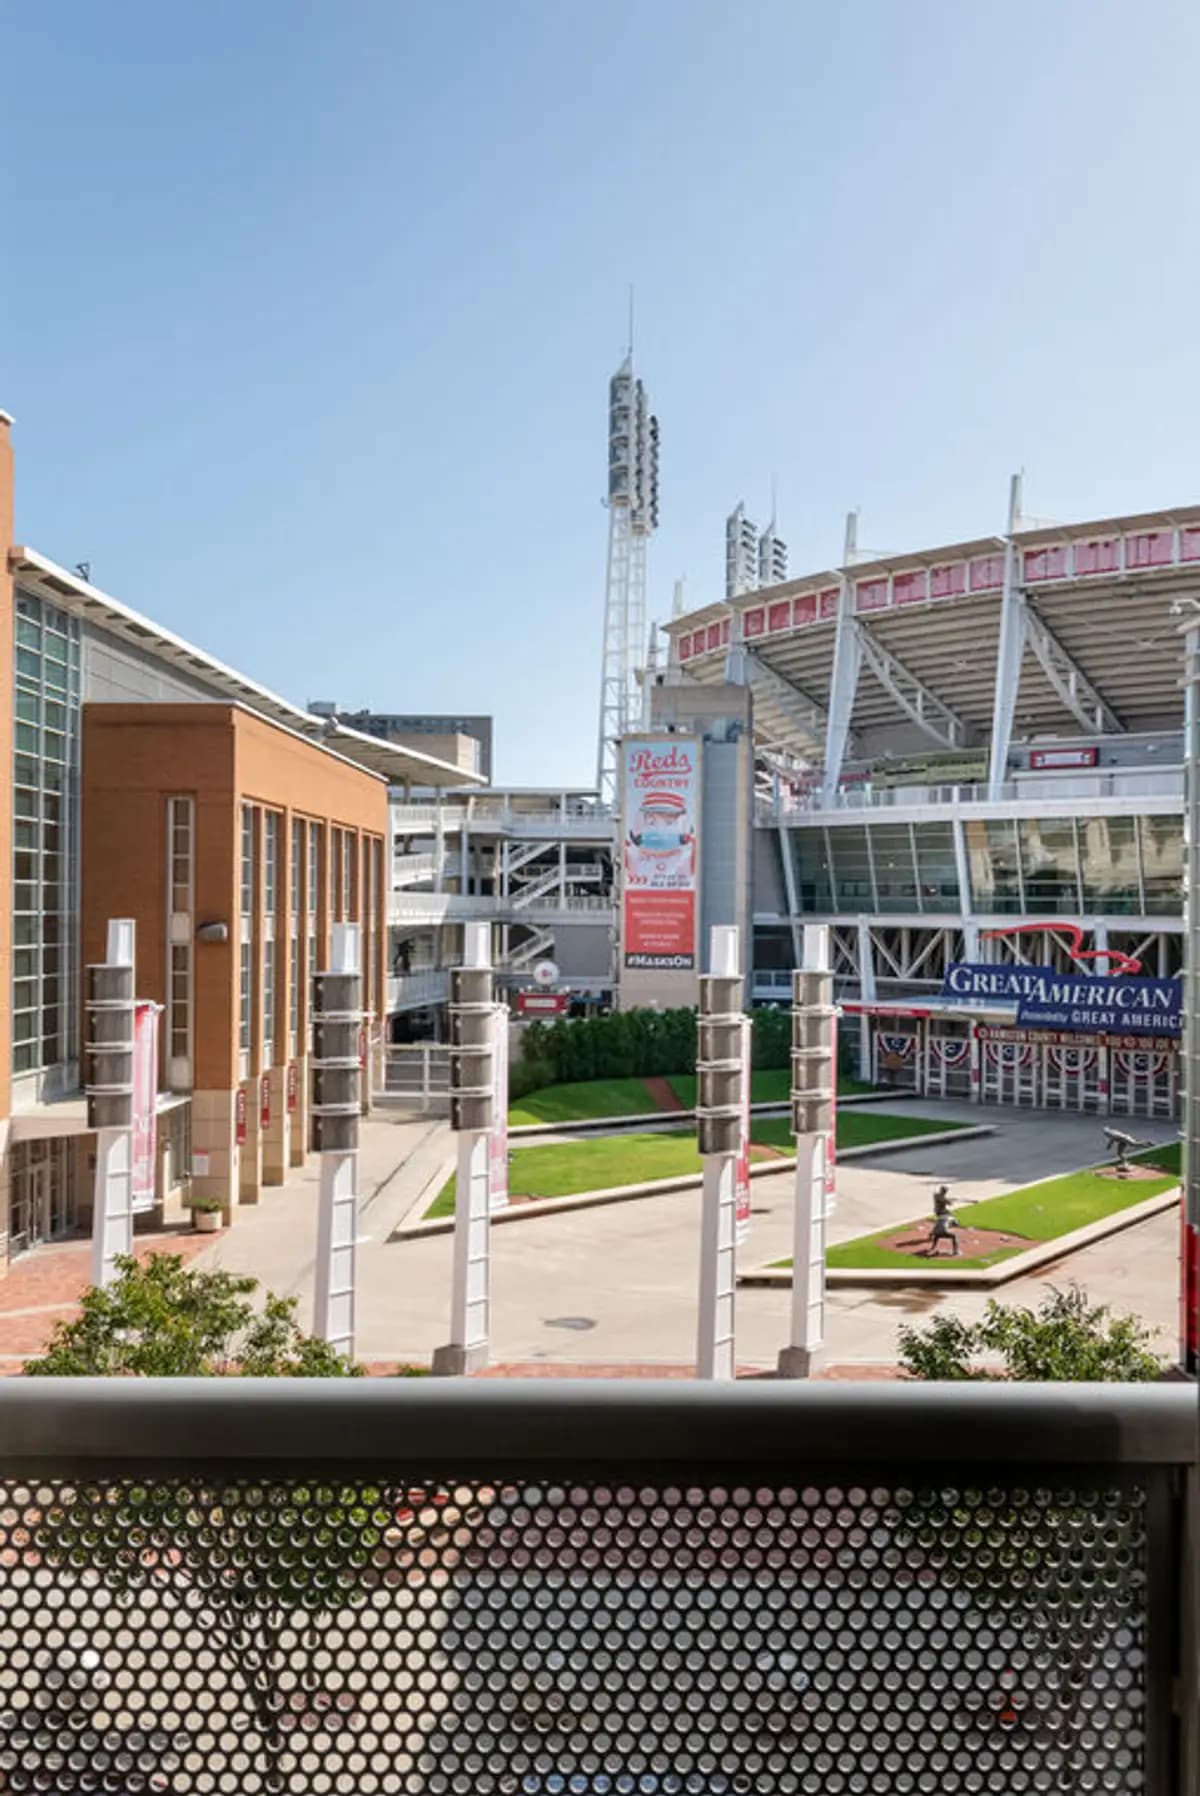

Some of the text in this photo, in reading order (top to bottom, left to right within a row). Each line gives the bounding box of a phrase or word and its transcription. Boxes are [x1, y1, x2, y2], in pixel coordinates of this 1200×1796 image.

[630, 745, 693, 775] Reds
[1027, 977, 1175, 1010] AMERICAN
[1072, 1009, 1115, 1025] GREAT
